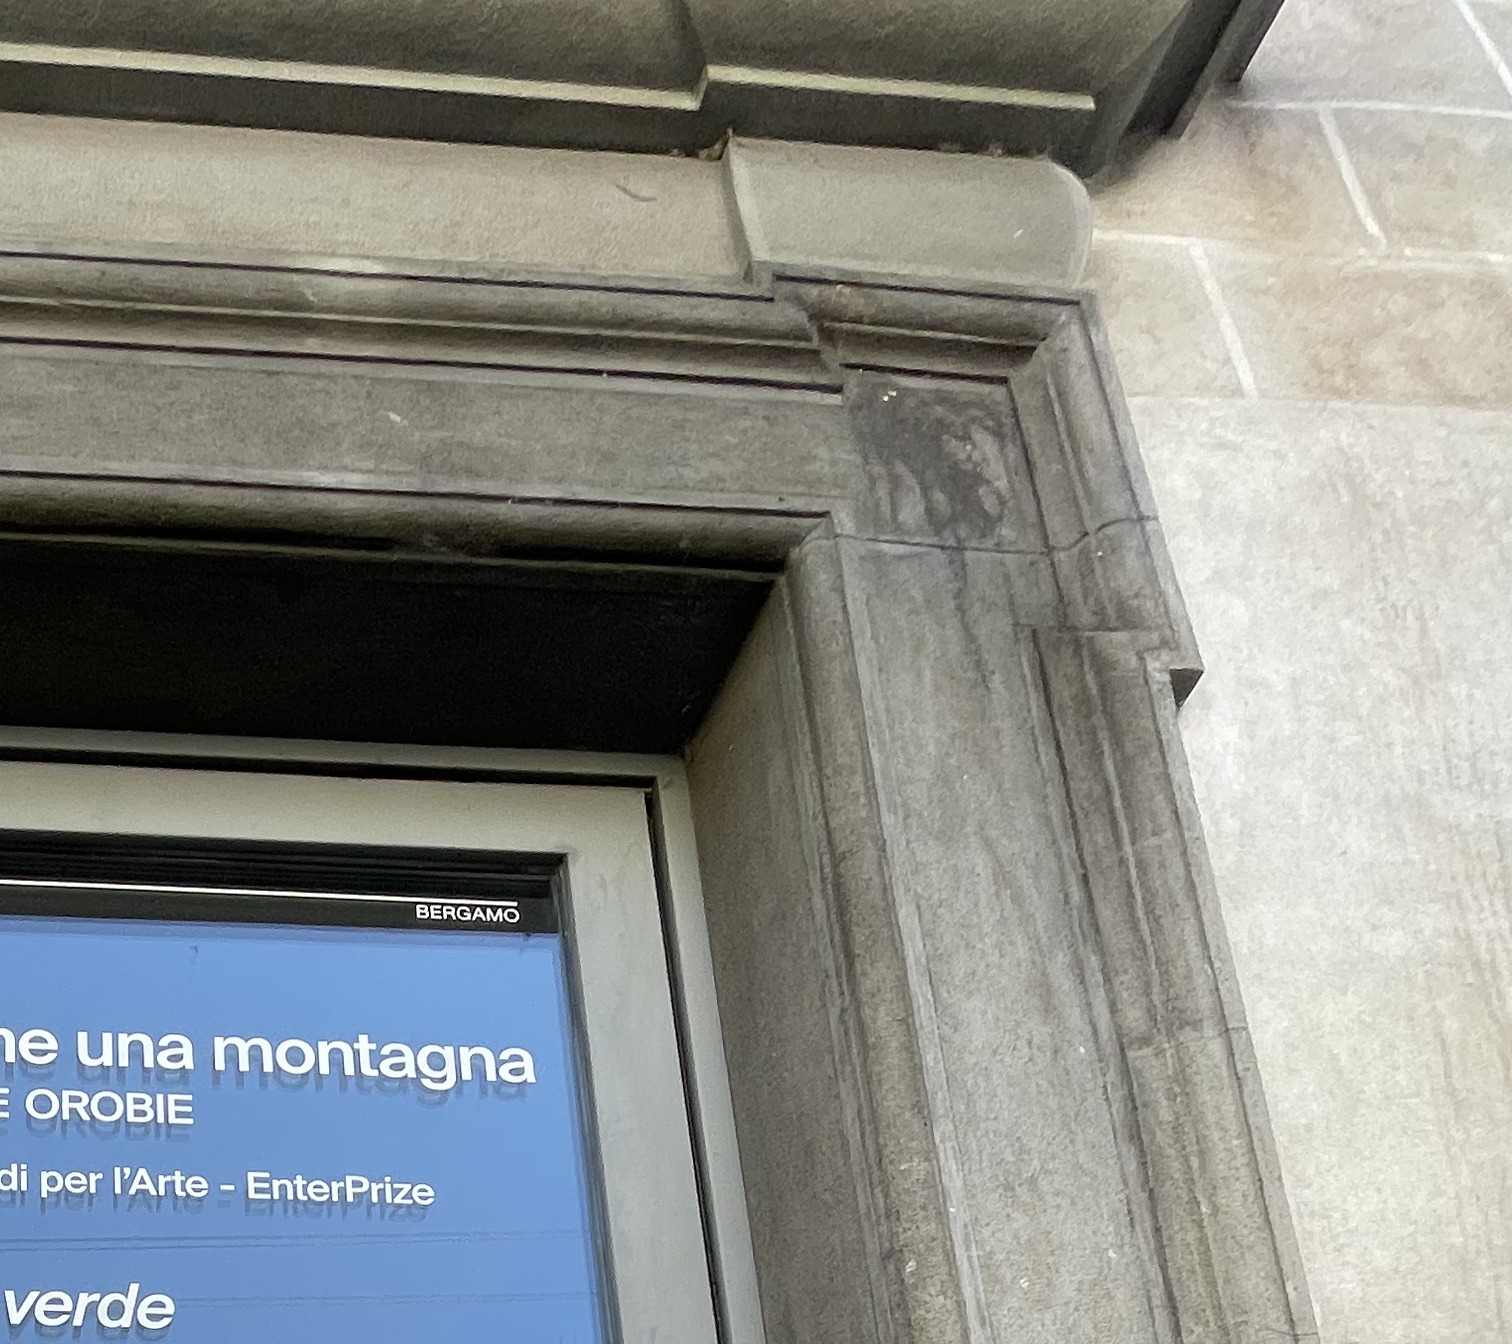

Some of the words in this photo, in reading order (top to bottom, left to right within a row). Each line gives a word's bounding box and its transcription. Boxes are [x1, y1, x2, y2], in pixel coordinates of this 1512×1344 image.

[416, 905, 519, 923] BERGAMO
[77, 1030, 194, 1070] una
[214, 1034, 537, 1091] montagna
[25, 1088, 194, 1125] OROBIE
[40, 1167, 103, 1198] per
[248, 1171, 435, 1205] EnterPrize
[4, 1283, 175, 1330] verde
